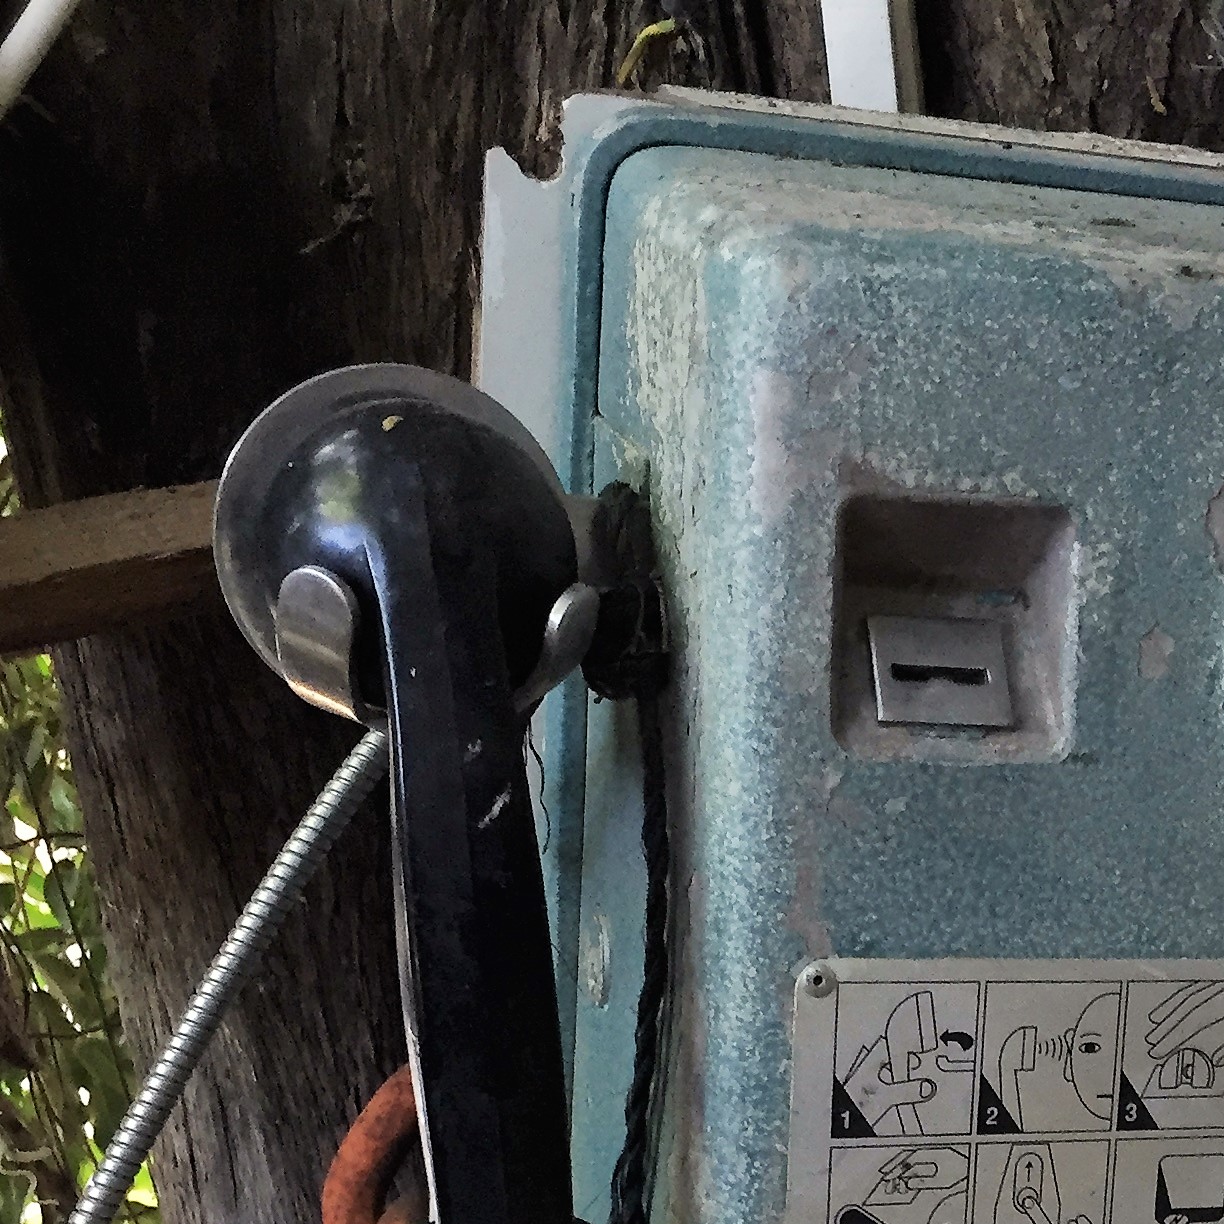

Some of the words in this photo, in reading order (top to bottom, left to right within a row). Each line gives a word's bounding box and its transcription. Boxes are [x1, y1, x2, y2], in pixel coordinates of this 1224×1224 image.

[841, 1110, 851, 1128] 1
[985, 1106, 998, 1125] 2
[1124, 1103, 1137, 1122] 3
